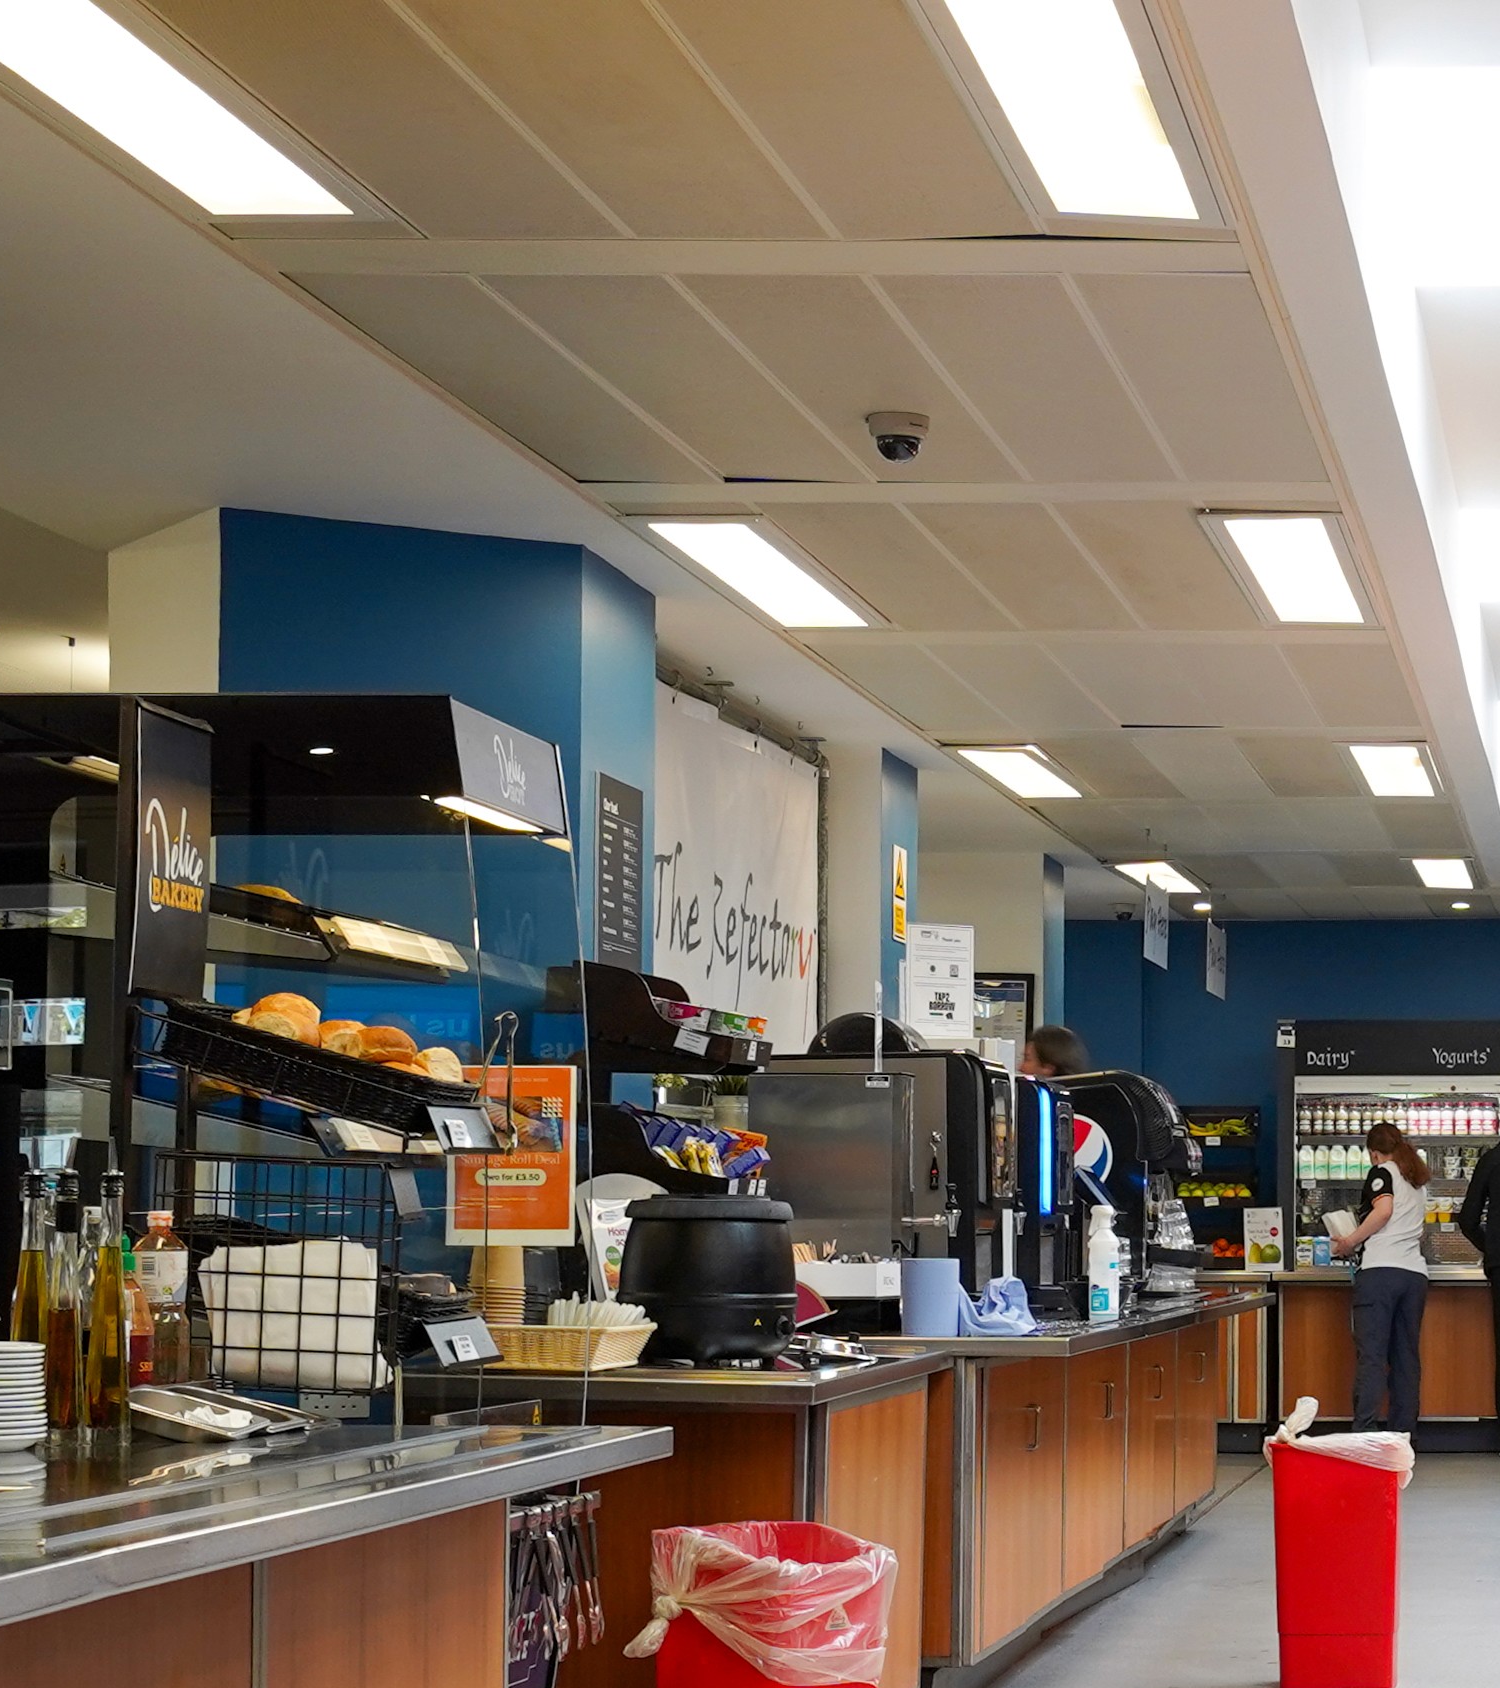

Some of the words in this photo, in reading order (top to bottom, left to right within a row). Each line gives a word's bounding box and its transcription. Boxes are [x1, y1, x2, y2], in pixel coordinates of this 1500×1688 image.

[145, 798, 203, 912] Délice
[151, 876, 205, 914] BAKERY
[654, 841, 702, 954] The
[706, 871, 814, 1041] Refectory
[934, 992, 950, 1001] TAP2
[460, 1154, 506, 1167] Sausage
[509, 1153, 531, 1165] Roll
[535, 1153, 560, 1165] Deal
[482, 1173, 500, 1181] Two
[502, 1173, 513, 1181] for
